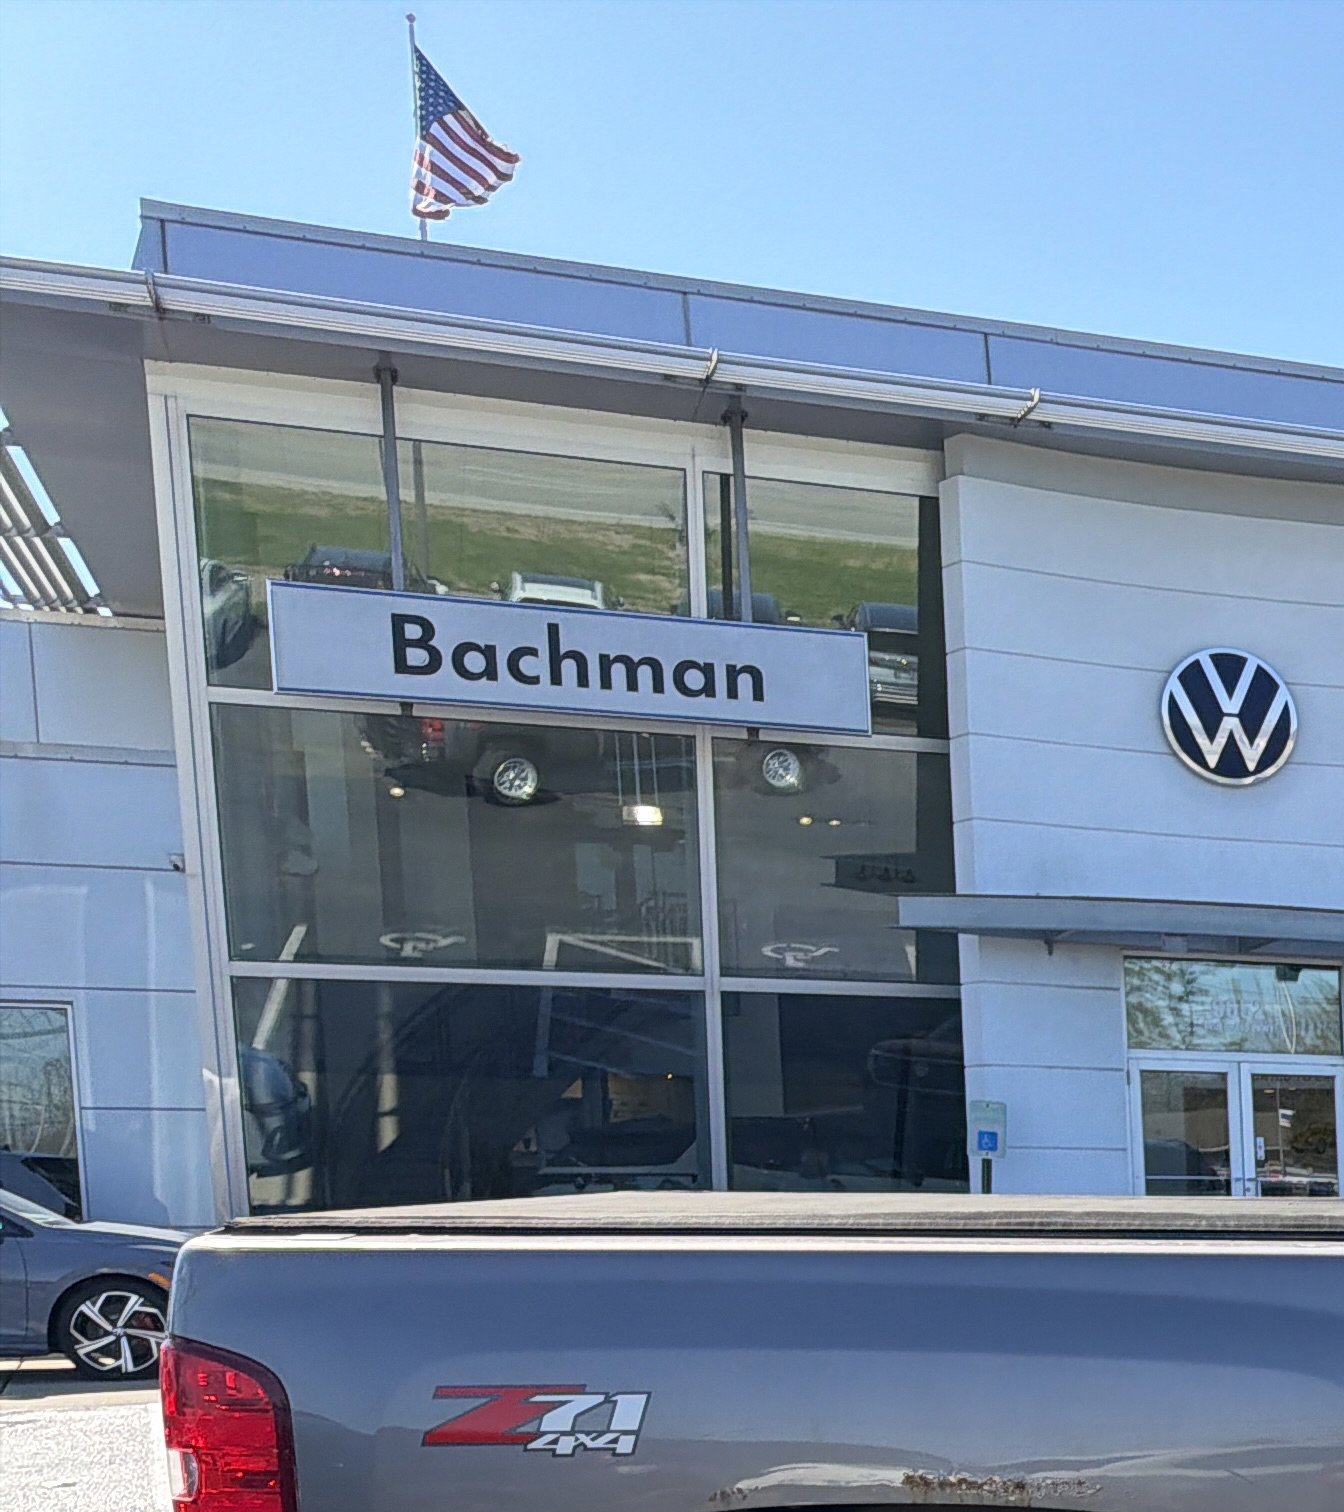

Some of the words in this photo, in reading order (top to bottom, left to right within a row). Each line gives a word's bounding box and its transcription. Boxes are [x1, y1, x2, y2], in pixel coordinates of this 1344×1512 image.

[391, 613, 765, 703] Bachman
[1168, 652, 1292, 776] VW
[421, 1384, 652, 1446] Z71
